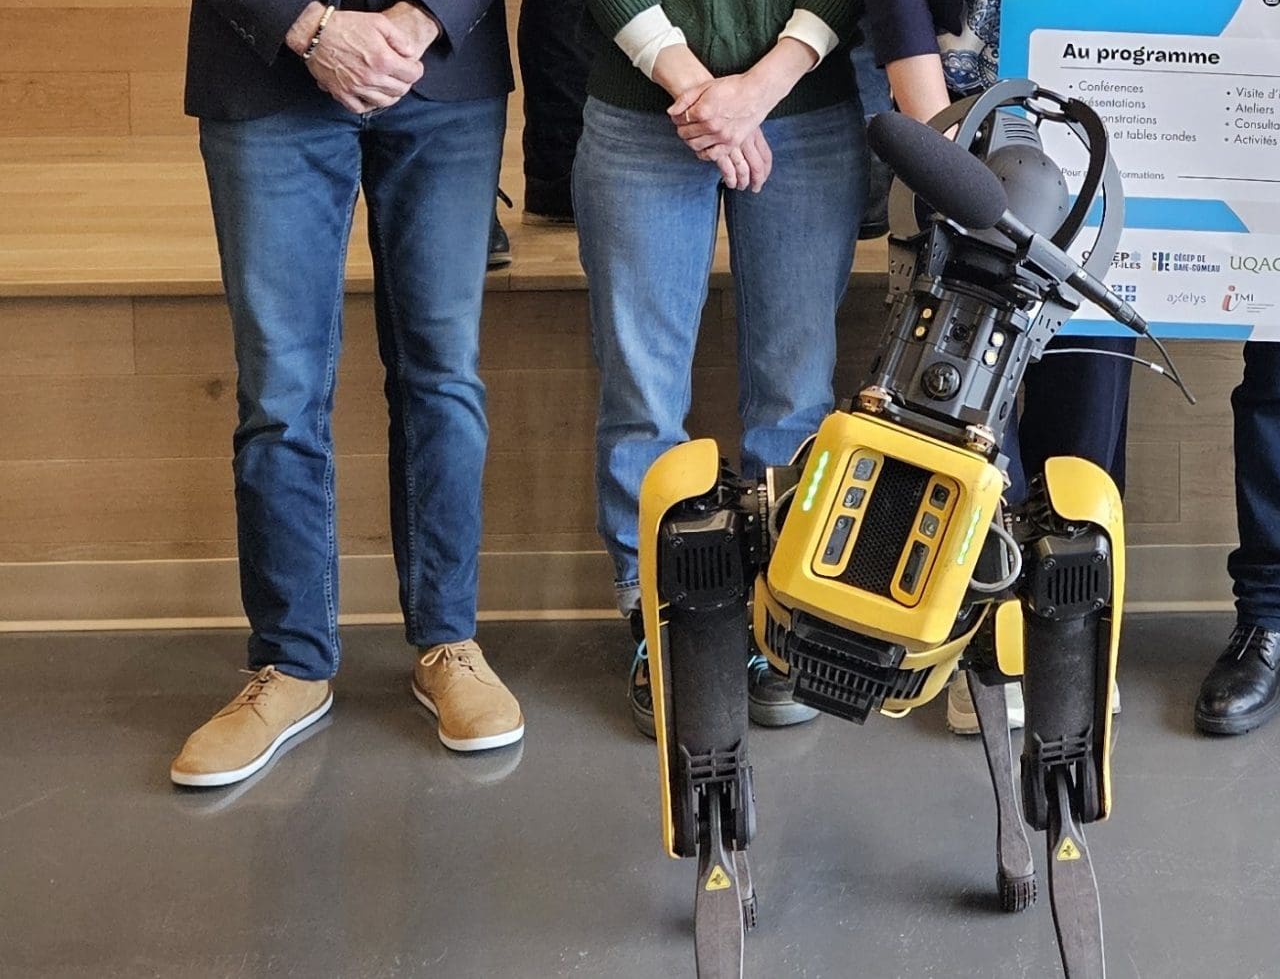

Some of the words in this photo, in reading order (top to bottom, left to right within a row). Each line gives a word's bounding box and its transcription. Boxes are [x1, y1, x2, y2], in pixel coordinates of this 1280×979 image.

[1062, 43, 1090, 60] Au
[1097, 46, 1221, 66] programme
[1078, 80, 1144, 93] Conférences
[1236, 87, 1265, 99] Visite
[1235, 103, 1275, 115] Ateliers
[1101, 114, 1158, 125] onstrations
[1113, 130, 1123, 140] et
[1126, 130, 1158, 141] tables
[1161, 131, 1197, 142] rondes
[1233, 133, 1278, 146] Activités
[1061, 167, 1081, 177] Pour
[1118, 170, 1166, 180] formations
[1081, 250, 1130, 262] CEP
[1173, 252, 1196, 262] CÉGEP
[1197, 254, 1207, 263] DE
[1173, 263, 1221, 273] BAIE-COMEAU
[1166, 292, 1207, 306] axelys
